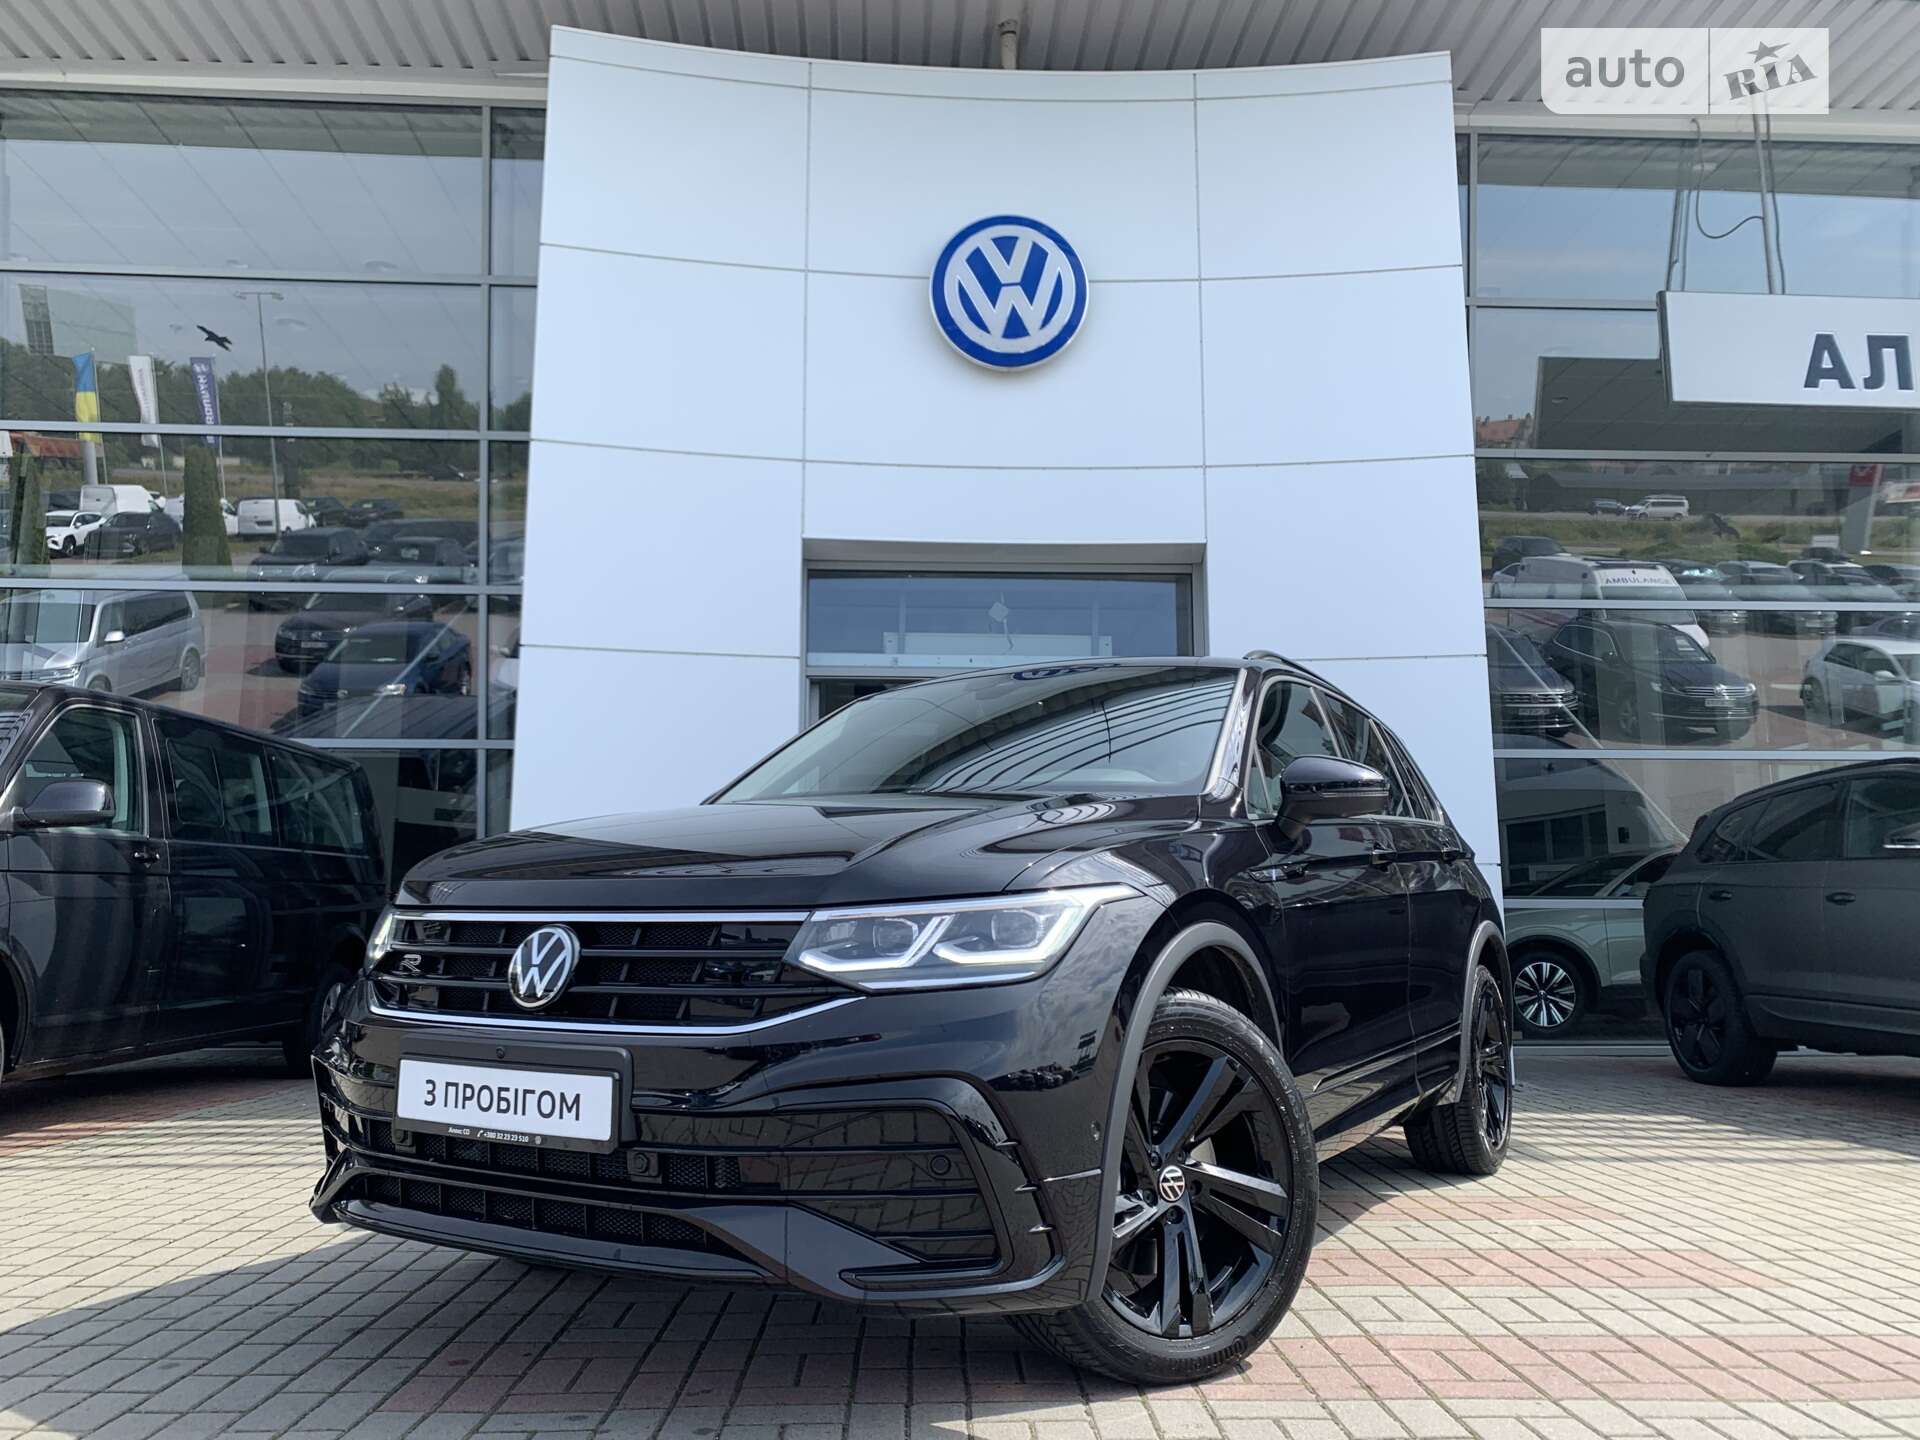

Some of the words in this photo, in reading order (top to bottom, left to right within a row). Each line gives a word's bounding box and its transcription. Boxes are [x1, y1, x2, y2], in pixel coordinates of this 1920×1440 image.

[944, 224, 1077, 354] VW
[1803, 333, 1914, 391] АЛ
[509, 927, 573, 1008] VW
[443, 1081, 582, 1122] ПРОБІГОМ
